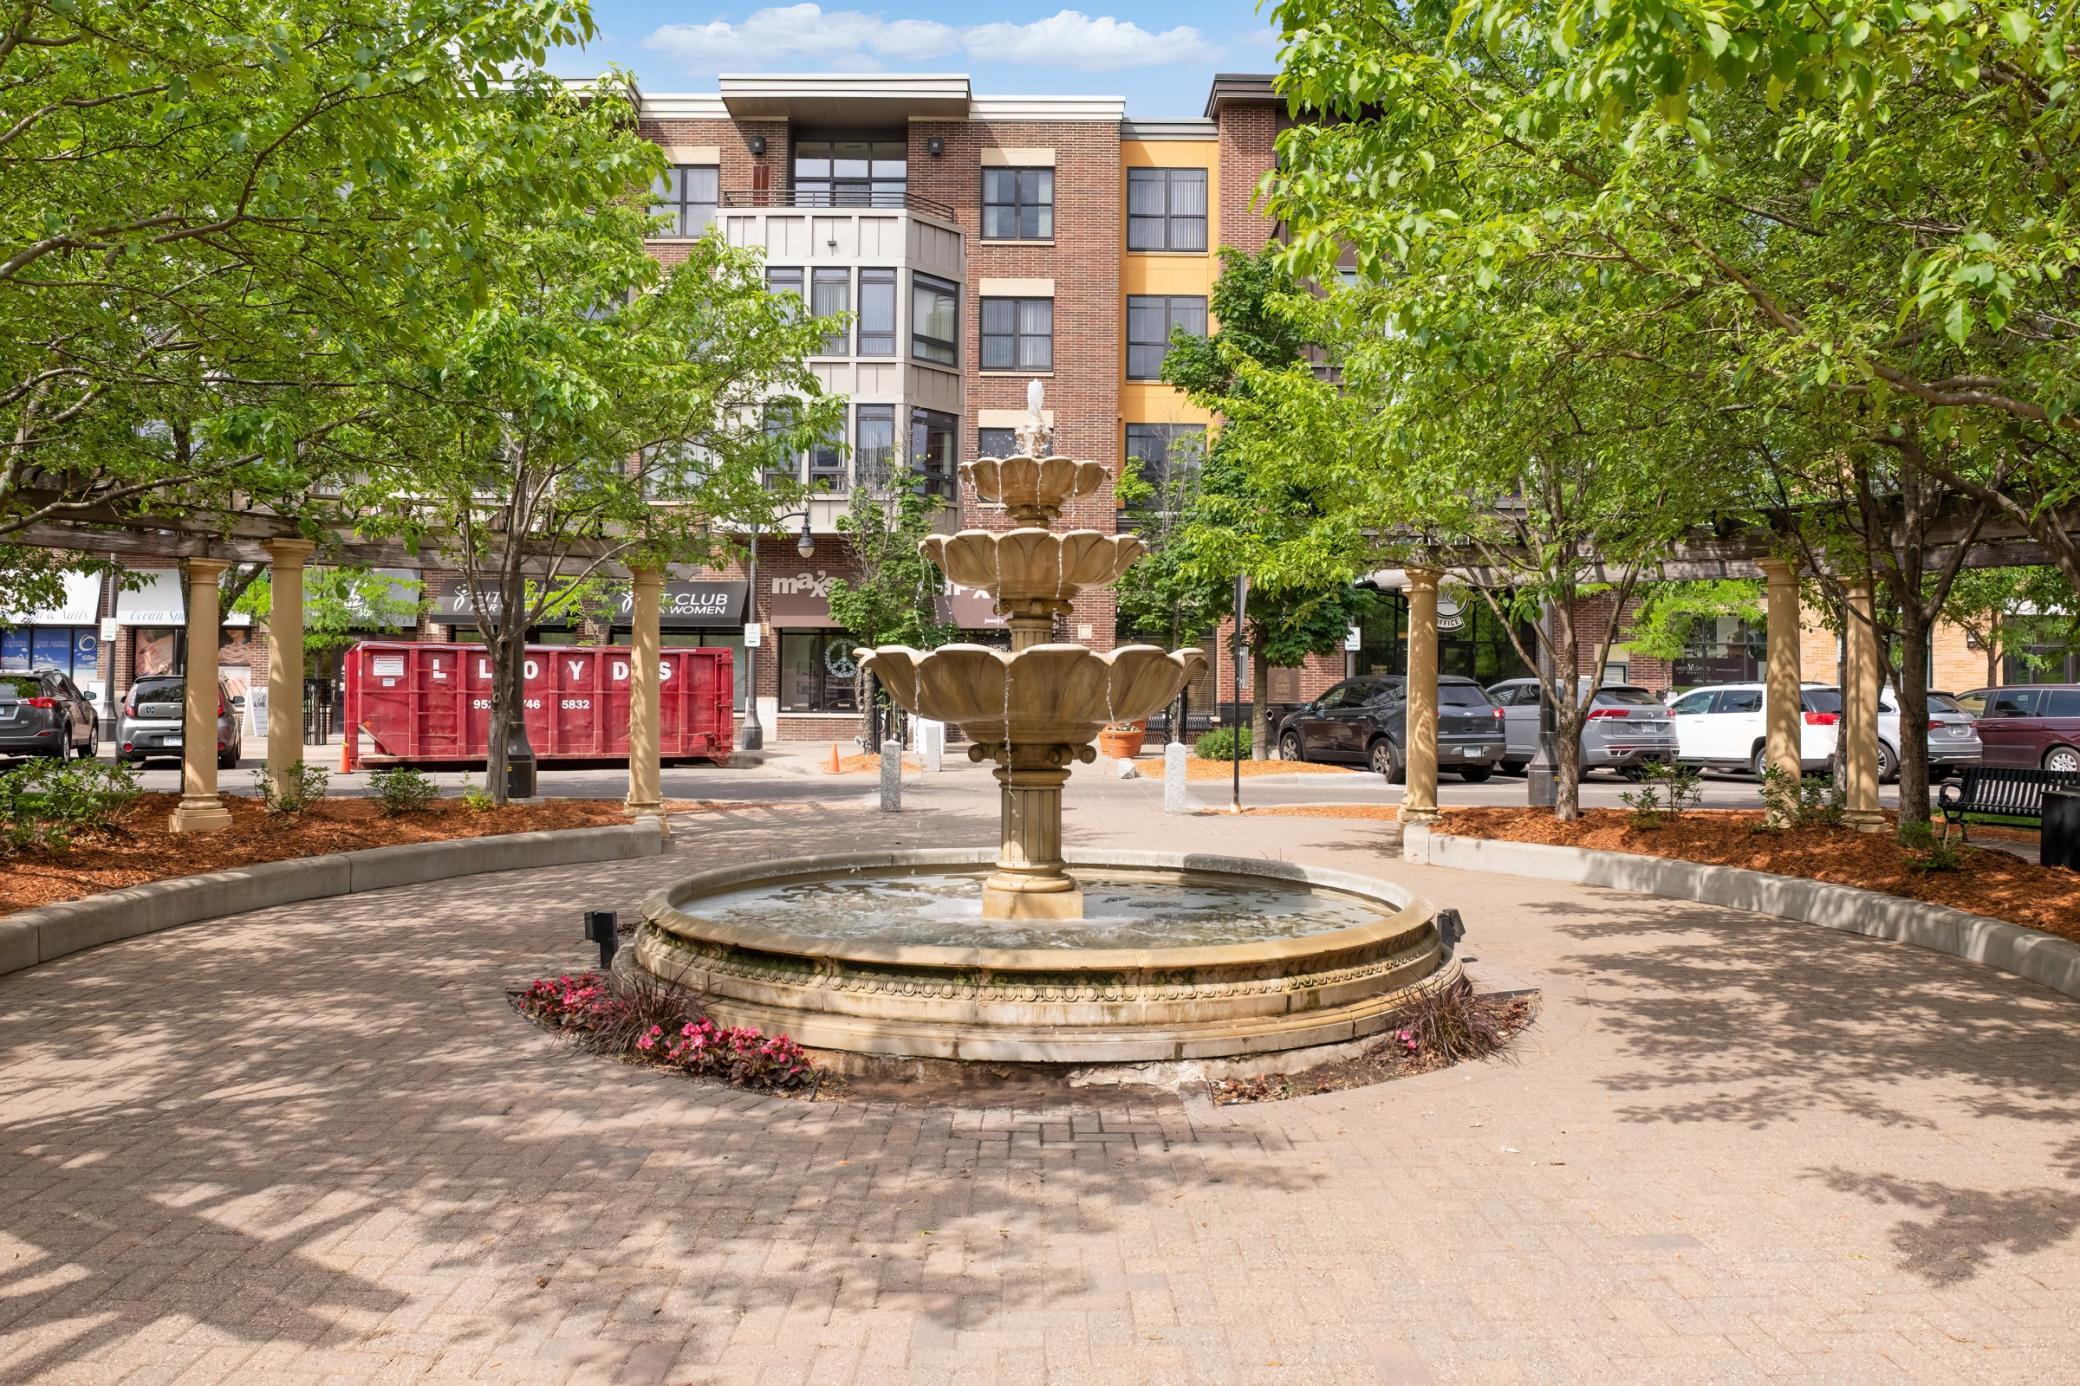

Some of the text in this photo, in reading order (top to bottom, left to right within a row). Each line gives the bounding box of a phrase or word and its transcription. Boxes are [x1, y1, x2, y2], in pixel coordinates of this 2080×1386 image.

[772, 570, 839, 598] max's
[675, 593, 728, 606] CLUB
[669, 606, 726, 615] WOMEN
[433, 659, 672, 681] LLOYDS
[523, 699, 541, 710] 46
[561, 699, 590, 710] 5832
